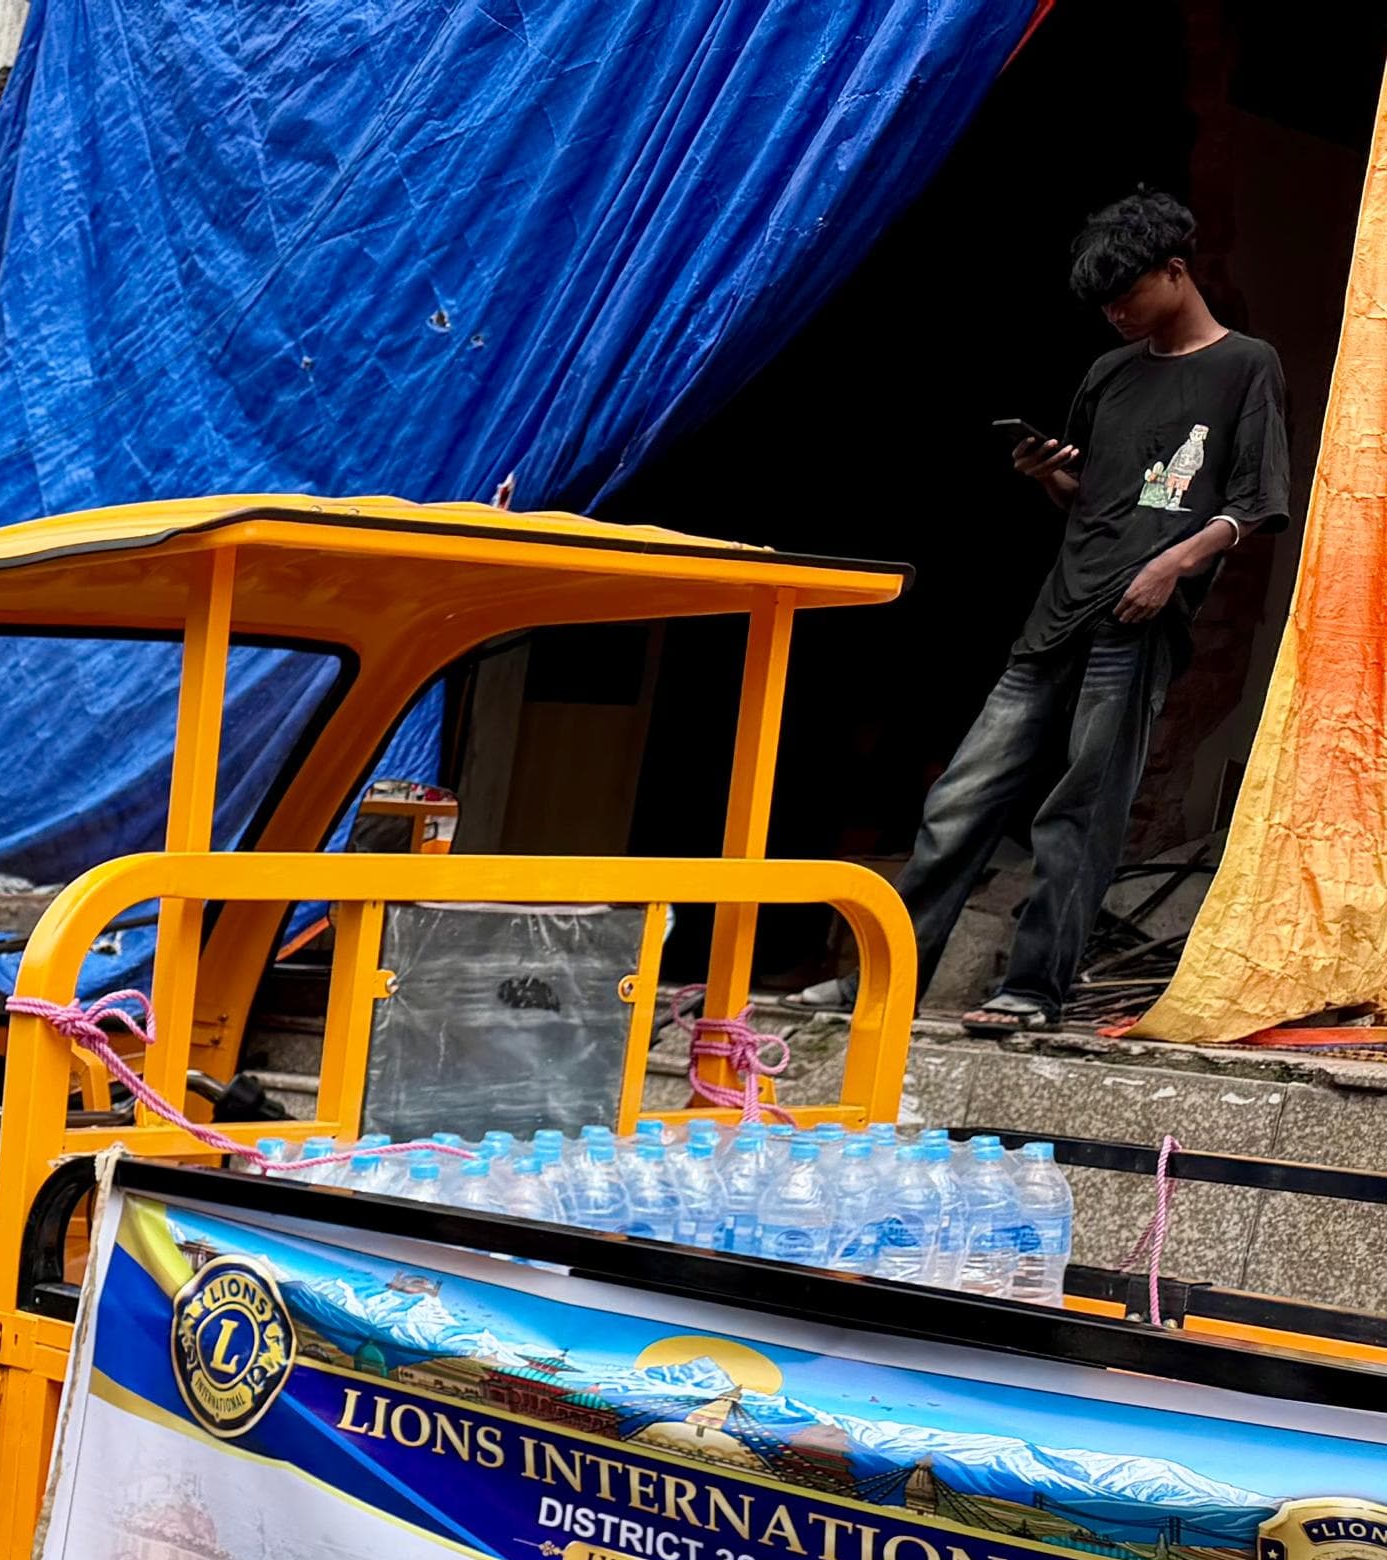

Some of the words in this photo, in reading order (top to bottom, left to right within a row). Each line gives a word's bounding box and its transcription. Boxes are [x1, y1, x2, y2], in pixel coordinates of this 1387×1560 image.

[208, 1277, 268, 1317] LIONS
[209, 1318, 240, 1374] L
[194, 1376, 247, 1416] INTERNATIONAL
[336, 1387, 506, 1469] LIONS
